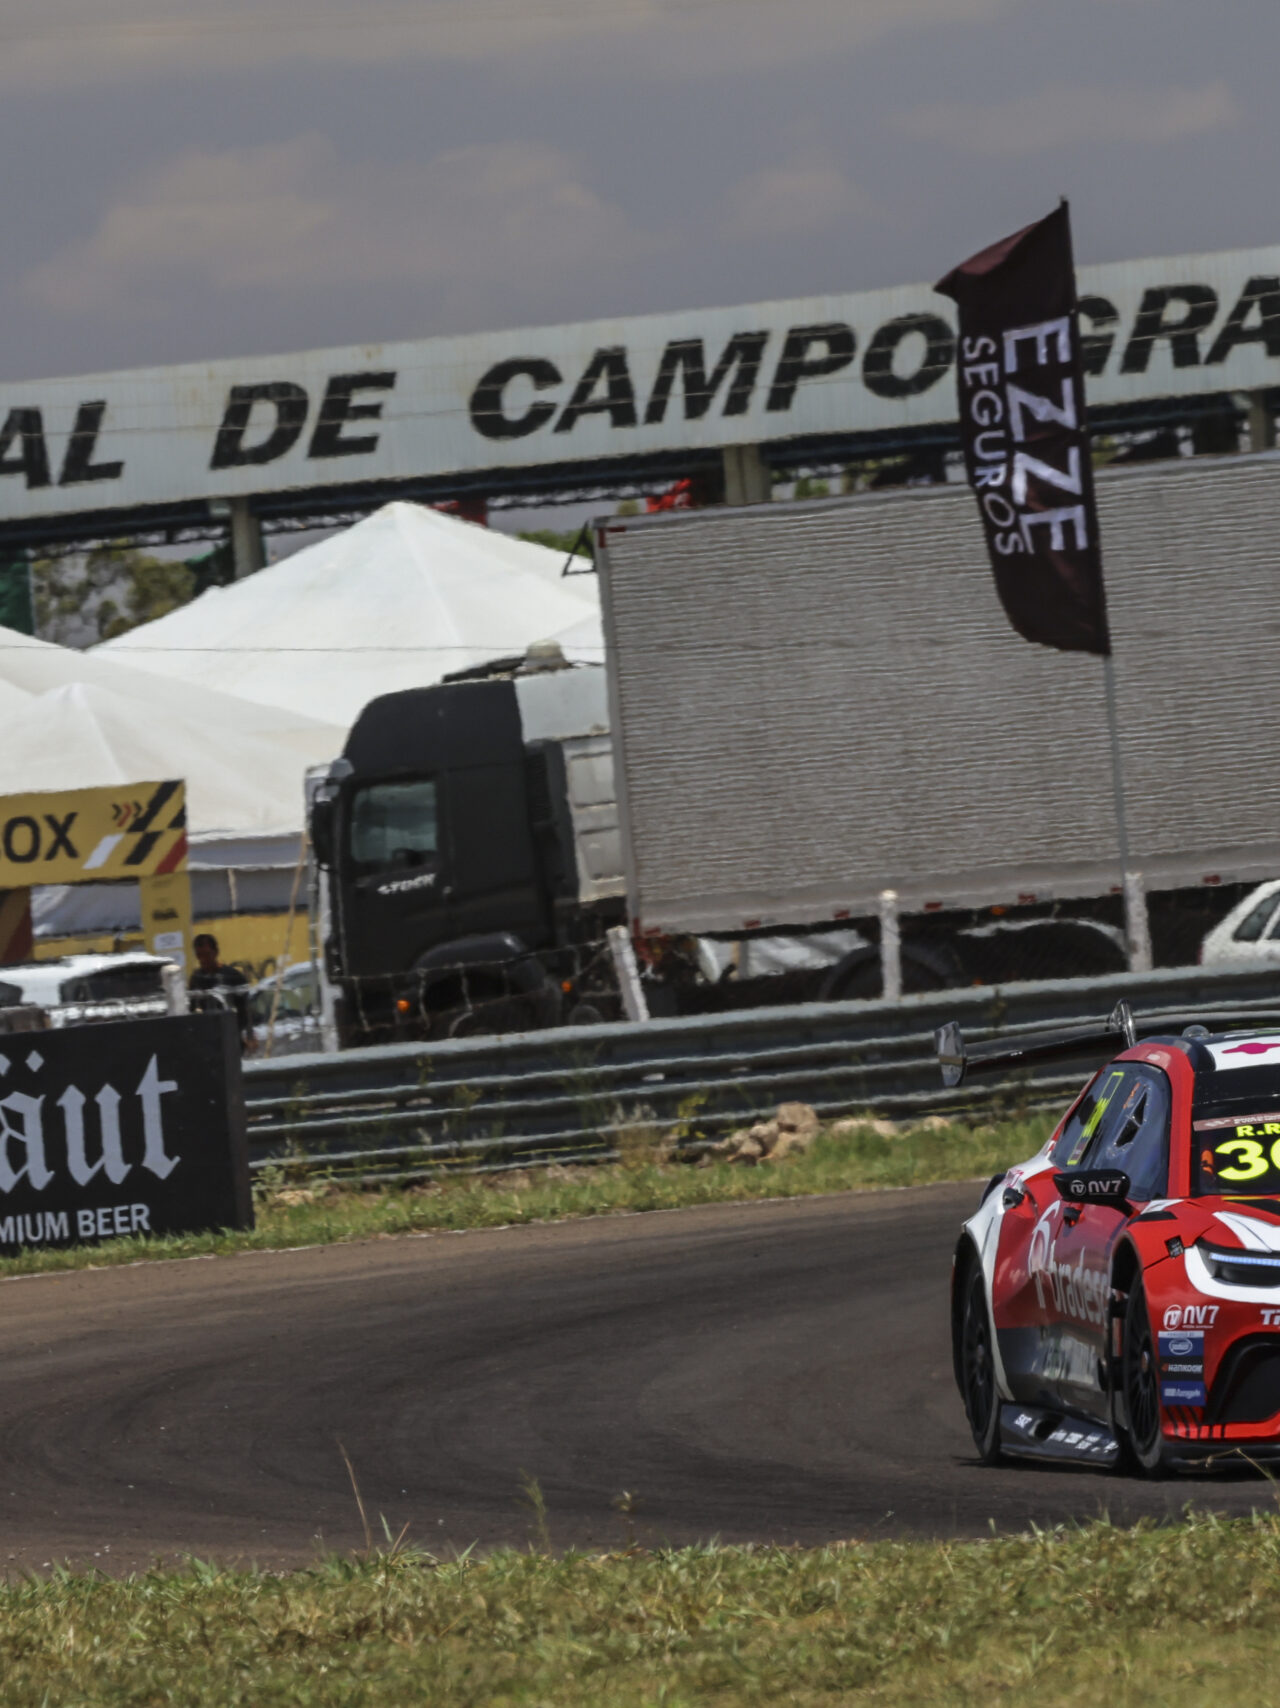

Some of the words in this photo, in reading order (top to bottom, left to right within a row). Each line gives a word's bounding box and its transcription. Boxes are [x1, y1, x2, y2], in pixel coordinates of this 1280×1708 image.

[209, 370, 396, 471] DE
[470, 313, 955, 439] CAMPO
[963, 335, 1024, 555] SEGUROS
[1003, 316, 1089, 554] EZZE
[3, 811, 80, 863] OX
[77, 1203, 151, 1237] BEER
